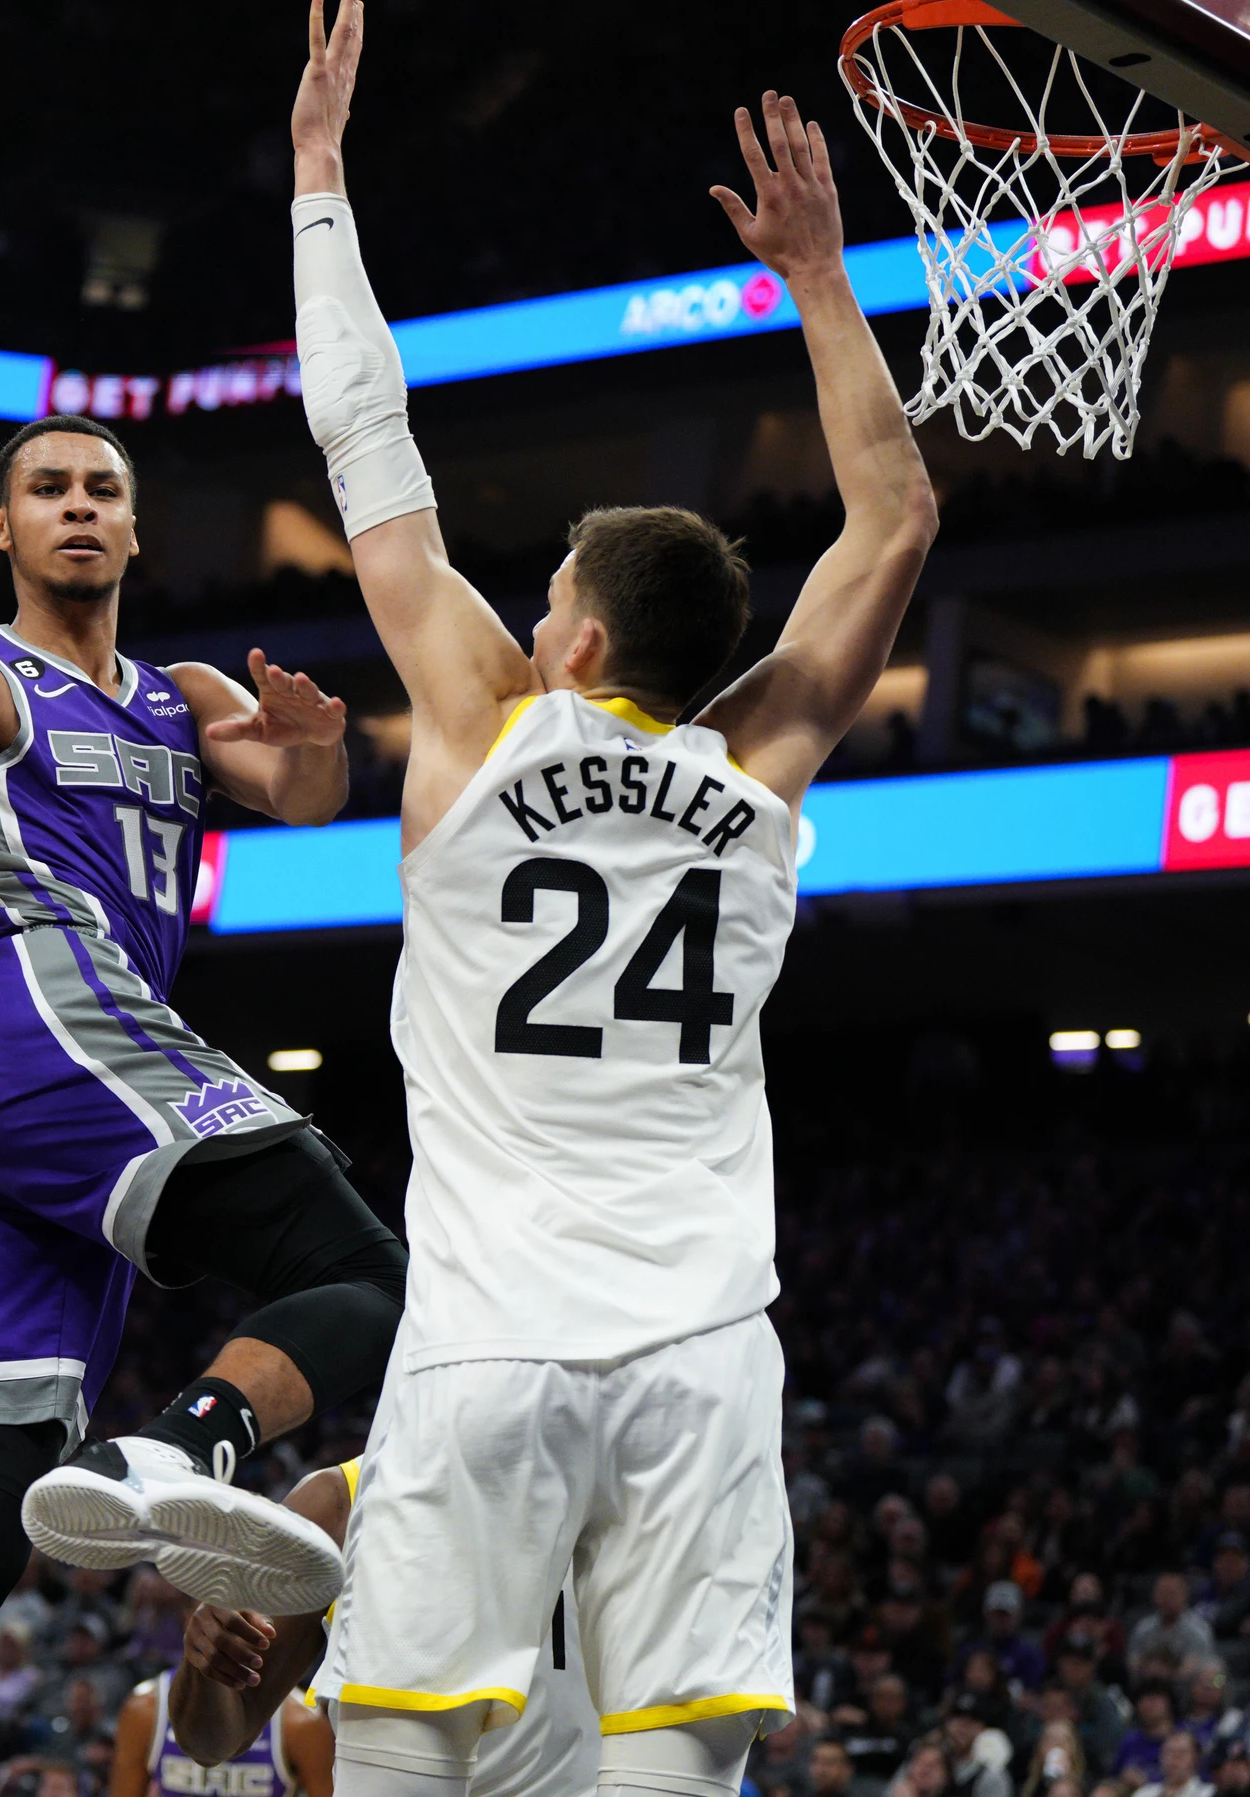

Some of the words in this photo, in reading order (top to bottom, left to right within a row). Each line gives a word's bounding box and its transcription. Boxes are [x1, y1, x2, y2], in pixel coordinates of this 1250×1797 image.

[1170, 196, 1250, 257] PU
[619, 279, 740, 337] ARCO
[15, 660, 39, 678] 6
[147, 703, 190, 718] ialpa
[47, 730, 202, 819] SAC
[498, 755, 756, 858] KESSLER
[114, 804, 187, 917] 13
[494, 857, 735, 1065] 24
[193, 1098, 268, 1139] SAC
[160, 1754, 274, 1797] SAC
